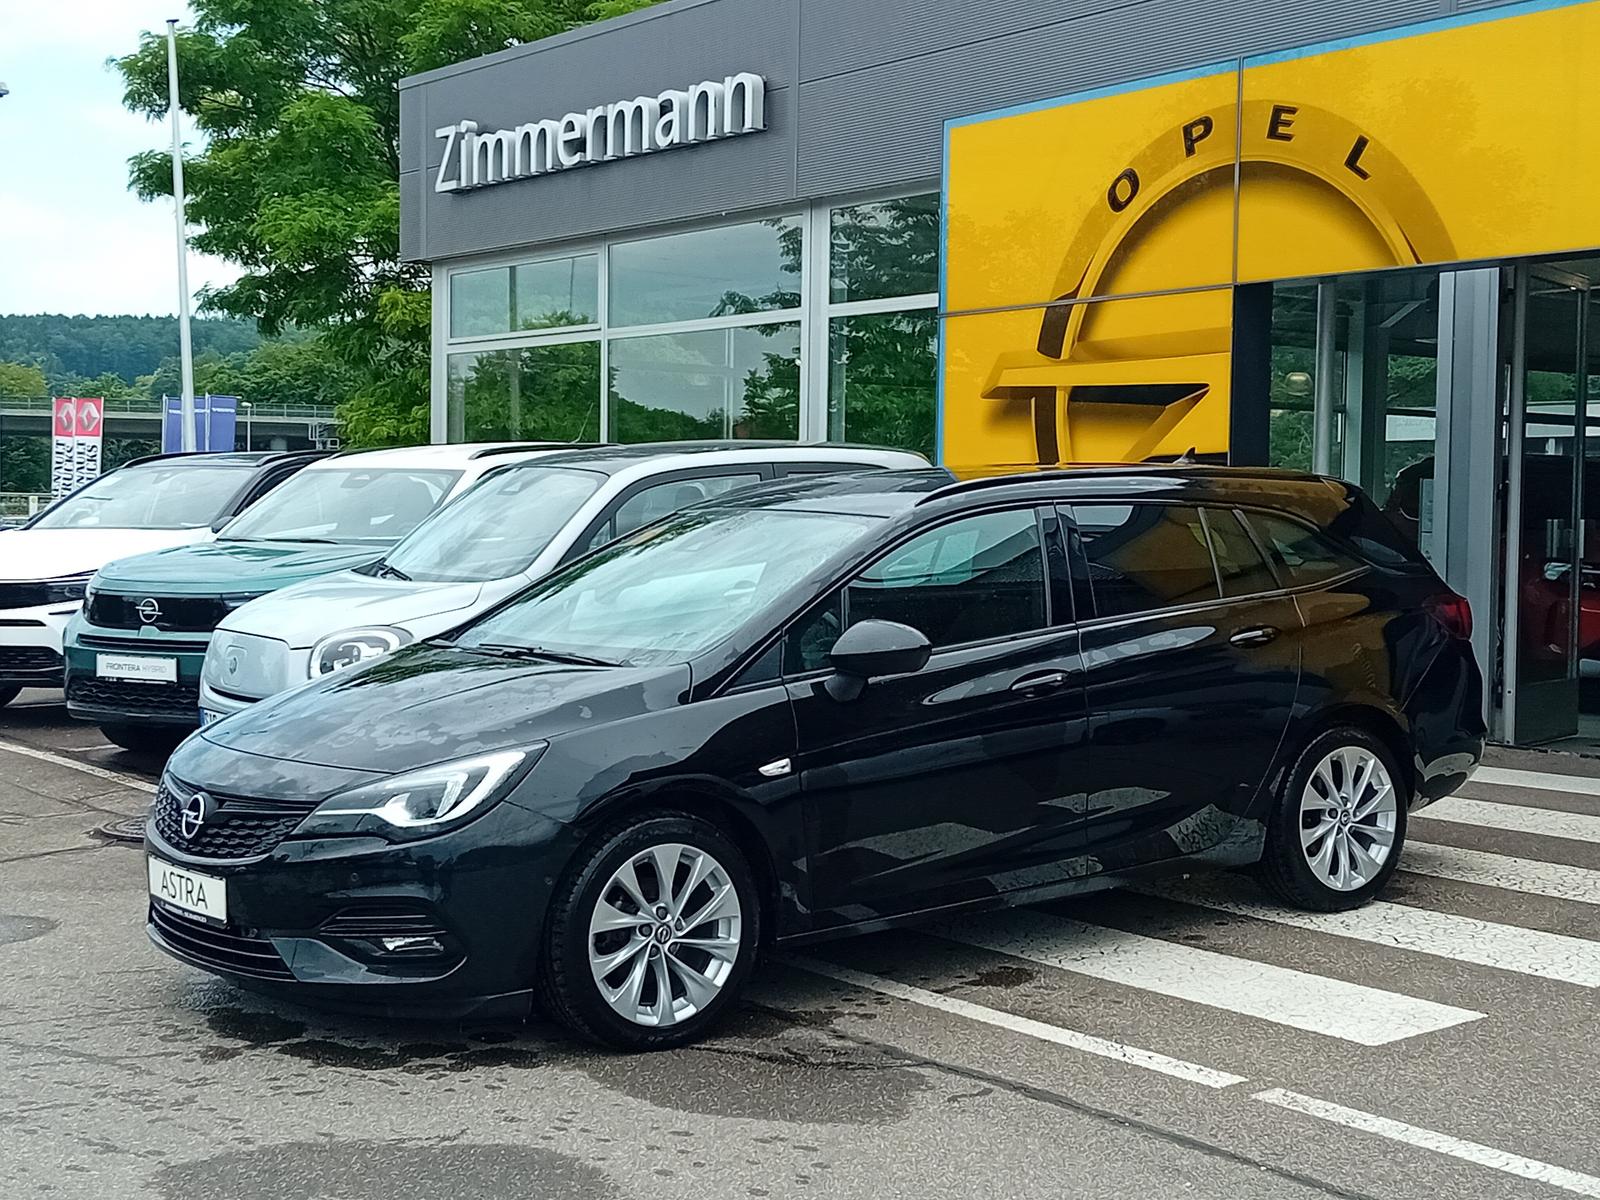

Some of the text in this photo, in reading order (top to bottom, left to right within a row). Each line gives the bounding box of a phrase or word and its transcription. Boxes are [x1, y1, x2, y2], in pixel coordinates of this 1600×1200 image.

[435, 72, 766, 193] Zimmermann
[1107, 104, 1371, 213] OPEL
[76, 440, 87, 486] NAULT
[86, 444, 98, 481] UCKS
[106, 662, 141, 672] FRONTERA
[161, 869, 208, 910] ASTRA
